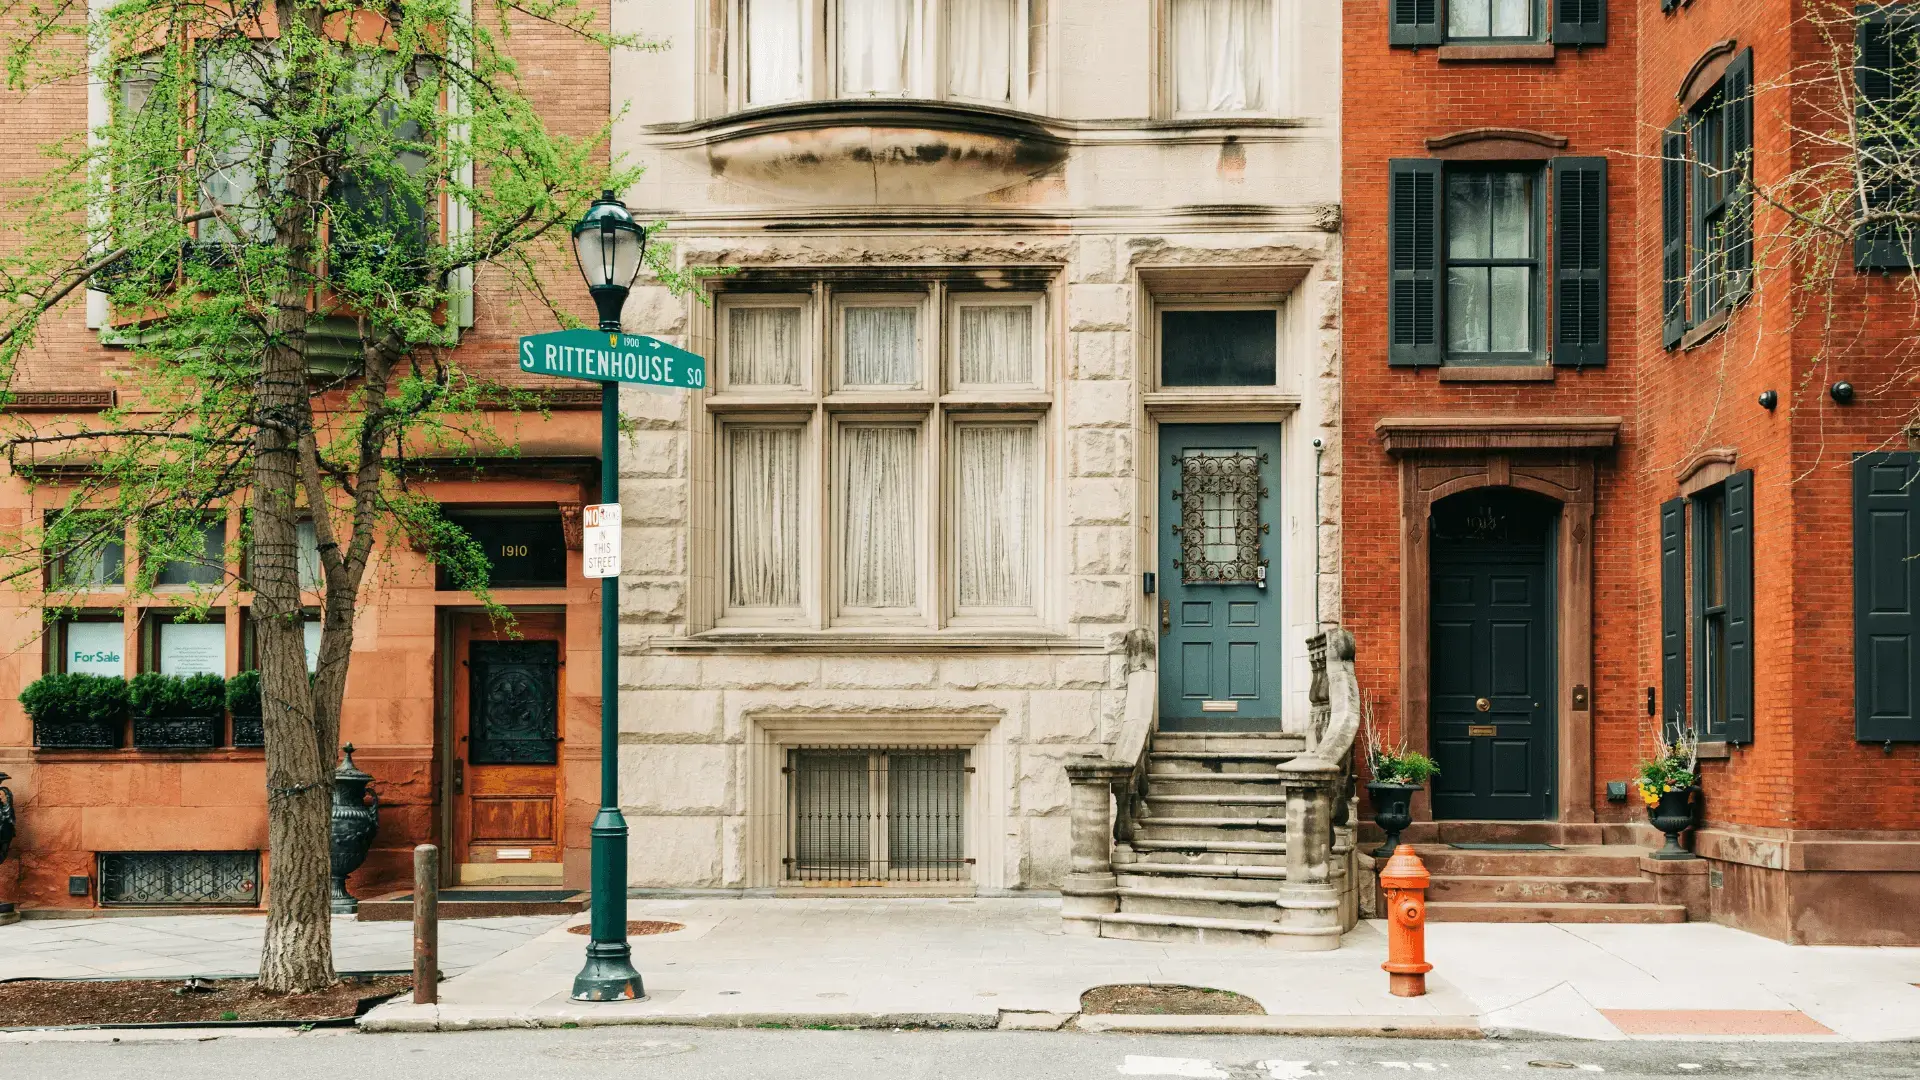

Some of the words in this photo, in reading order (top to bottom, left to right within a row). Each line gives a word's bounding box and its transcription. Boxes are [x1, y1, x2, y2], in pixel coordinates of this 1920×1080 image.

[624, 337, 640, 347] 1900
[523, 341, 534, 368] S
[545, 344, 674, 383] RITTENHOUSE
[687, 367, 702, 386] SQ
[585, 508, 599, 526] NO
[502, 545, 527, 556] 1910
[593, 542, 611, 554] THIS
[588, 556, 616, 568] STREET
[74, 651, 95, 662] For
[96, 651, 120, 662] Sale
